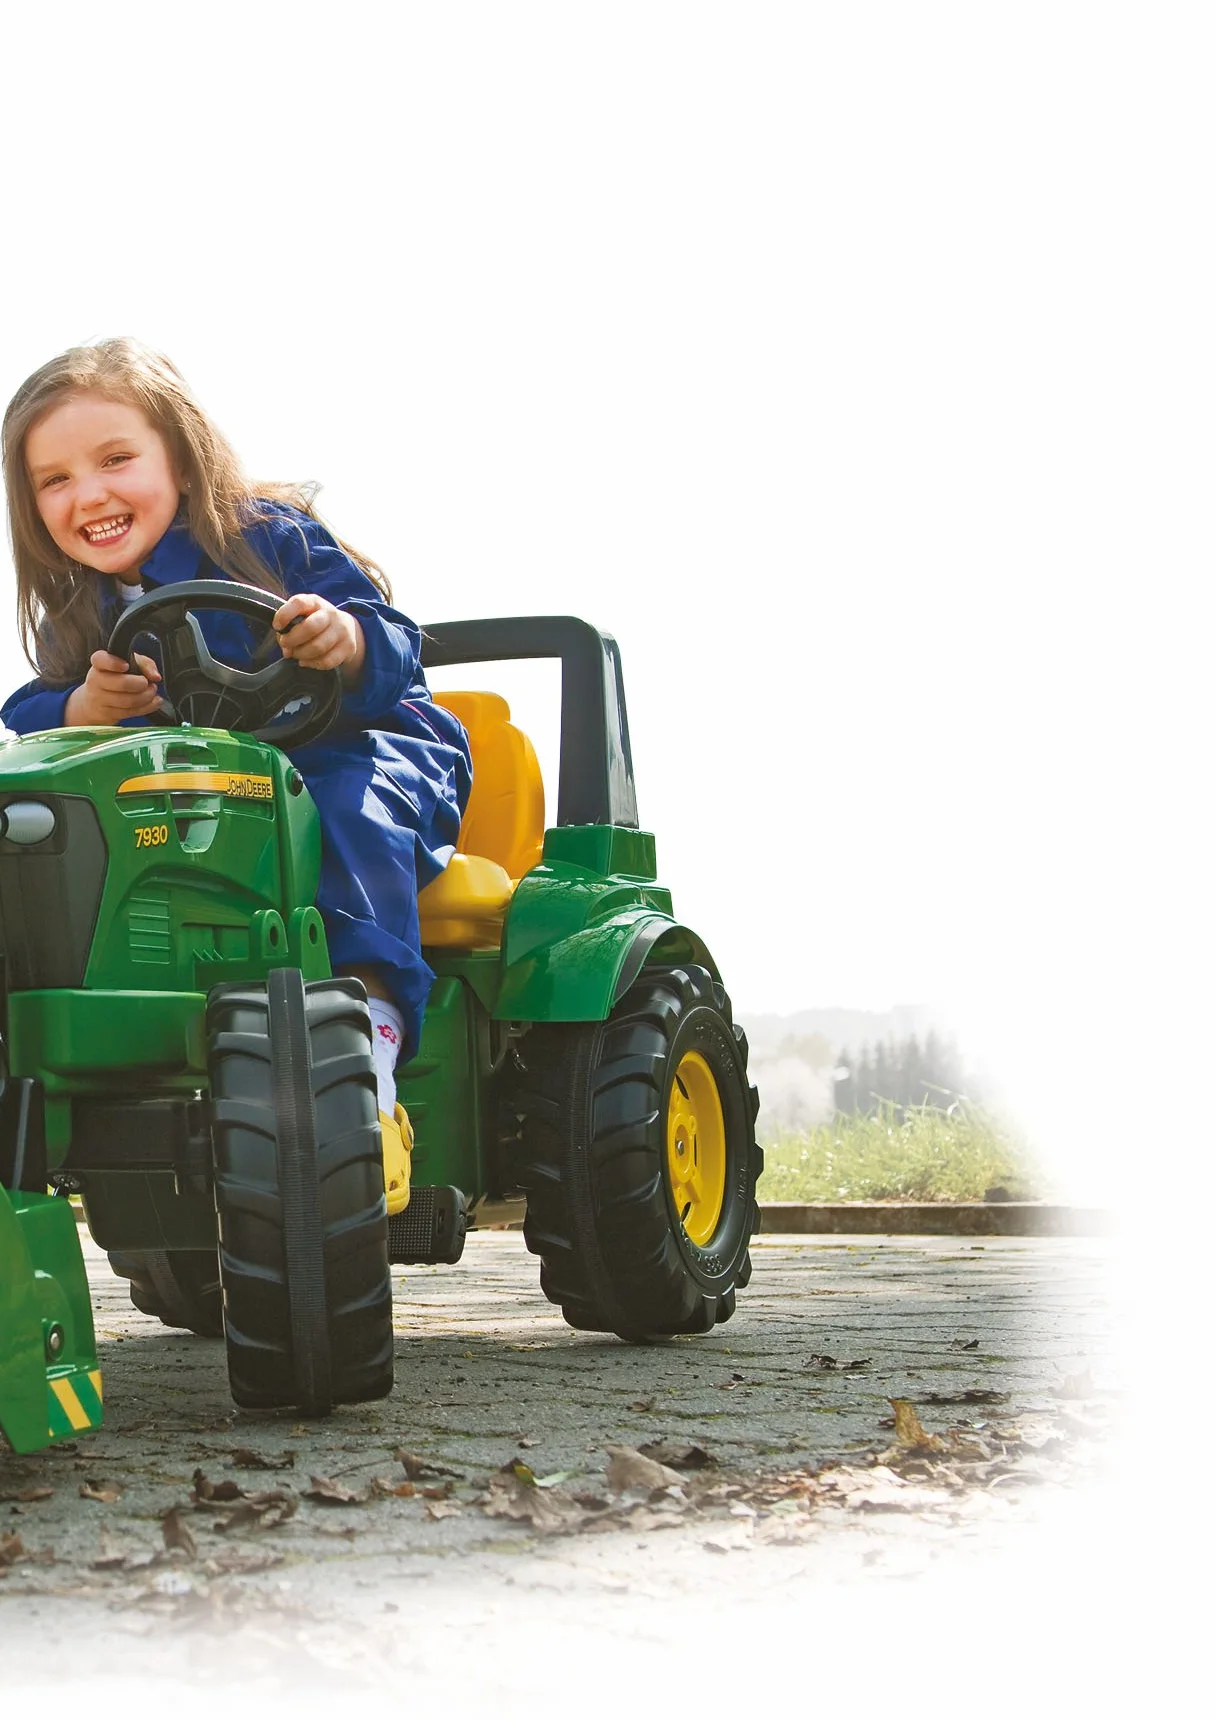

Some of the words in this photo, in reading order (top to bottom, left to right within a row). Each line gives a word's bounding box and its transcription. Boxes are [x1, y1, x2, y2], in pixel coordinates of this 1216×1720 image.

[227, 776, 246, 795] JOHN
[246, 778, 272, 796] DEERE
[135, 825, 168, 848] 7930
